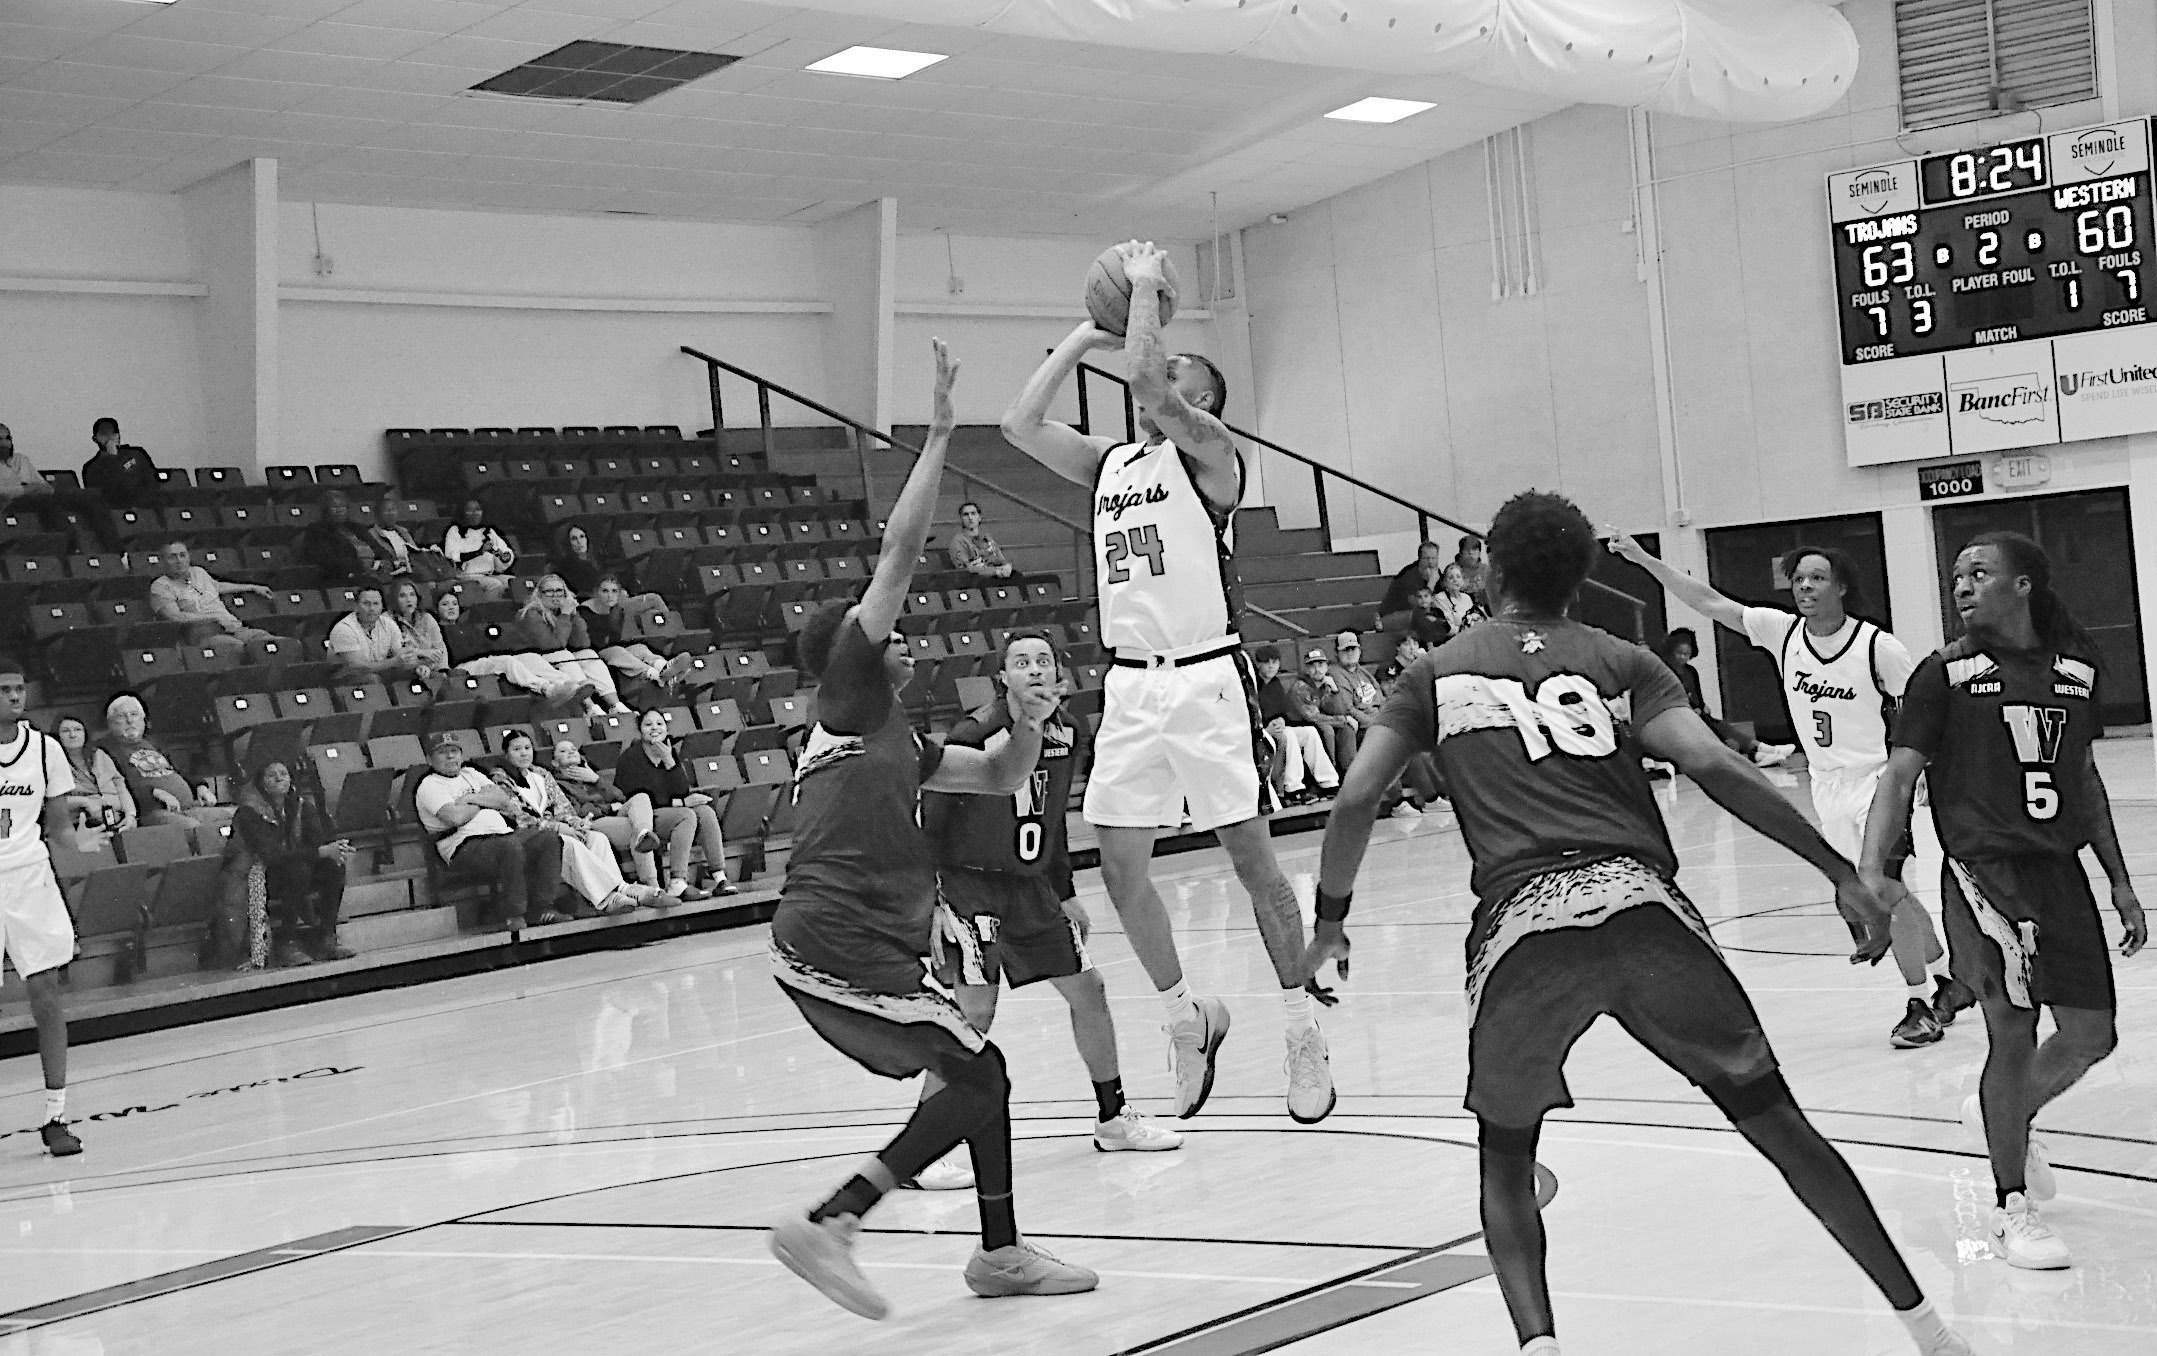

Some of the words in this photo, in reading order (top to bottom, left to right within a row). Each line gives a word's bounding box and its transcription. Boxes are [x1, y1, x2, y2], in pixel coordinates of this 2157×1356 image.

[2071, 136, 2126, 159] SEMINOLE
[1950, 144, 2043, 197] 8:24
[1849, 177, 1898, 198] SEMINOLE
[2054, 177, 2136, 209] WESTERN
[1845, 214, 1918, 244] TROJANS
[1964, 209, 2010, 230] PERIOD
[2077, 205, 2134, 254] 60
[1978, 232, 1998, 265] 2
[2098, 251, 2141, 271] FOULS
[1863, 241, 1915, 288] 63
[2049, 261, 2083, 276] T.O.L.
[1904, 284, 1936, 300] T.O.L.
[1952, 273, 1999, 293] PLAYER
[2001, 268, 2035, 286] FOUL
[2117, 270, 2138, 299] 7
[1851, 289, 1890, 308] FOULS
[2067, 280, 2079, 308] 1
[1868, 307, 1888, 336] 7
[1912, 300, 1932, 333] 3
[2102, 307, 2146, 326] SCORE
[1975, 326, 2018, 345] MATCH
[1855, 343, 1895, 361] SCORE
[1885, 392, 1940, 409] SECURITY
[1959, 386, 2049, 413] BancFirst
[2131, 384, 2157, 395] WISEL
[1886, 406, 1913, 418] STATE
[1913, 402, 1942, 415] BANK
[2008, 458, 2032, 478] EXIT
[1929, 478, 1973, 496] 1000
[1105, 523, 1165, 585] 24
[1792, 670, 1858, 703] Trojans
[1812, 709, 1833, 748] 3
[2024, 771, 2059, 820] 5
[1019, 822, 1042, 861] 0
